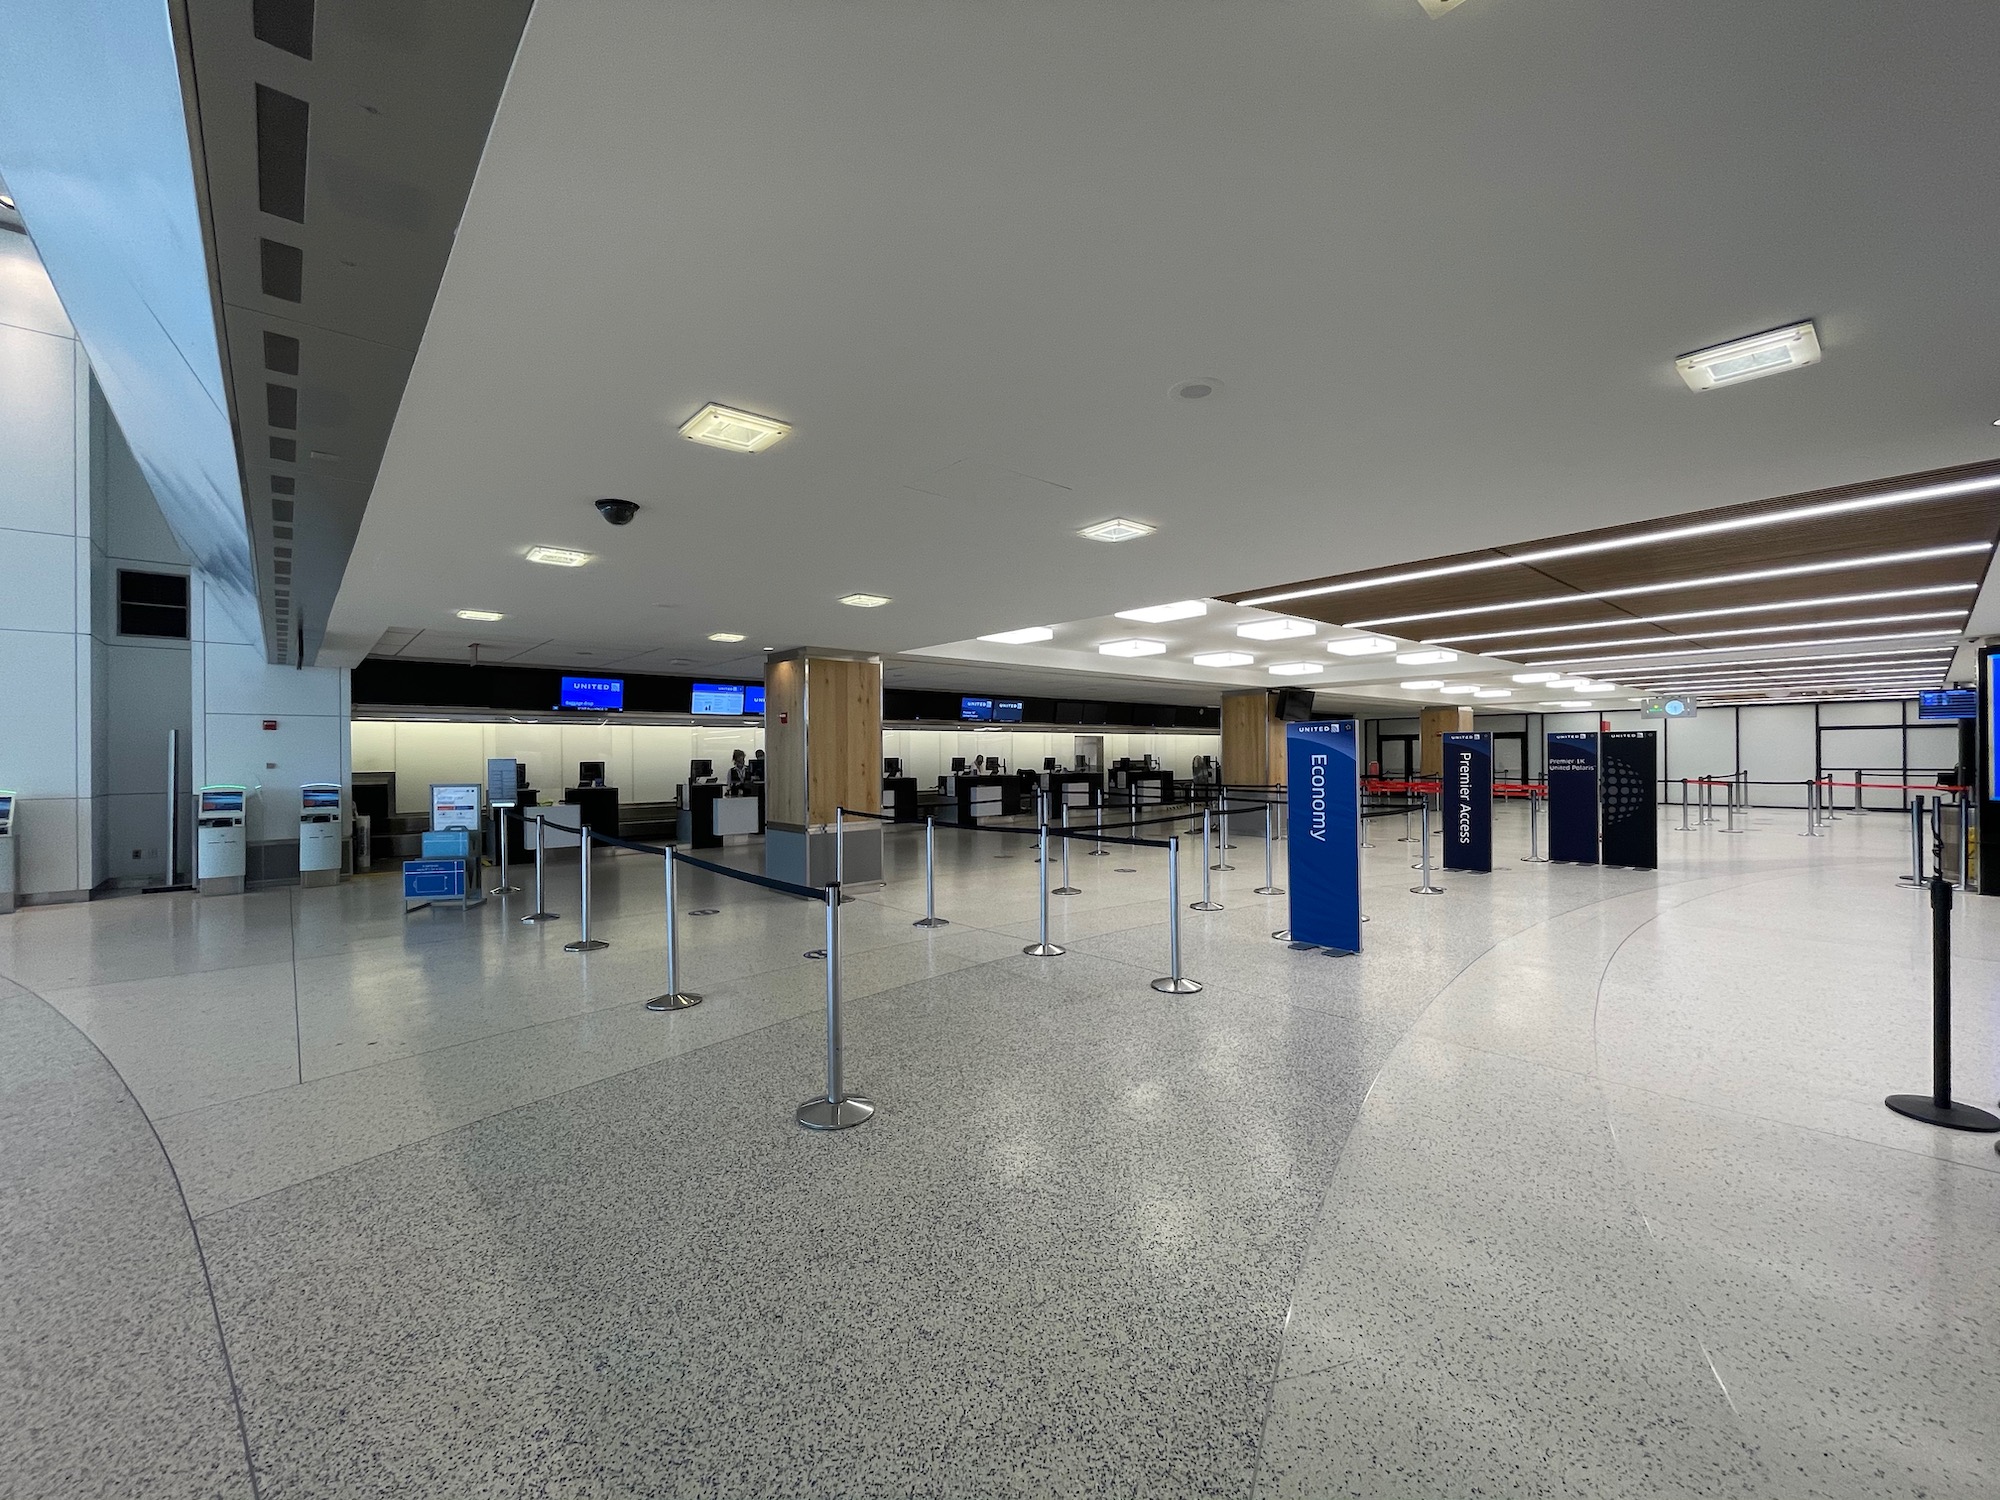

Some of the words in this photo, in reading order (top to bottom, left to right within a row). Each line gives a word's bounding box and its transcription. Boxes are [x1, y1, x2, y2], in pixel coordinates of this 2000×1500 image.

[1310, 754, 1327, 842] Economy
[1460, 753, 1472, 800] Premier
[1460, 803, 1472, 844] Access
